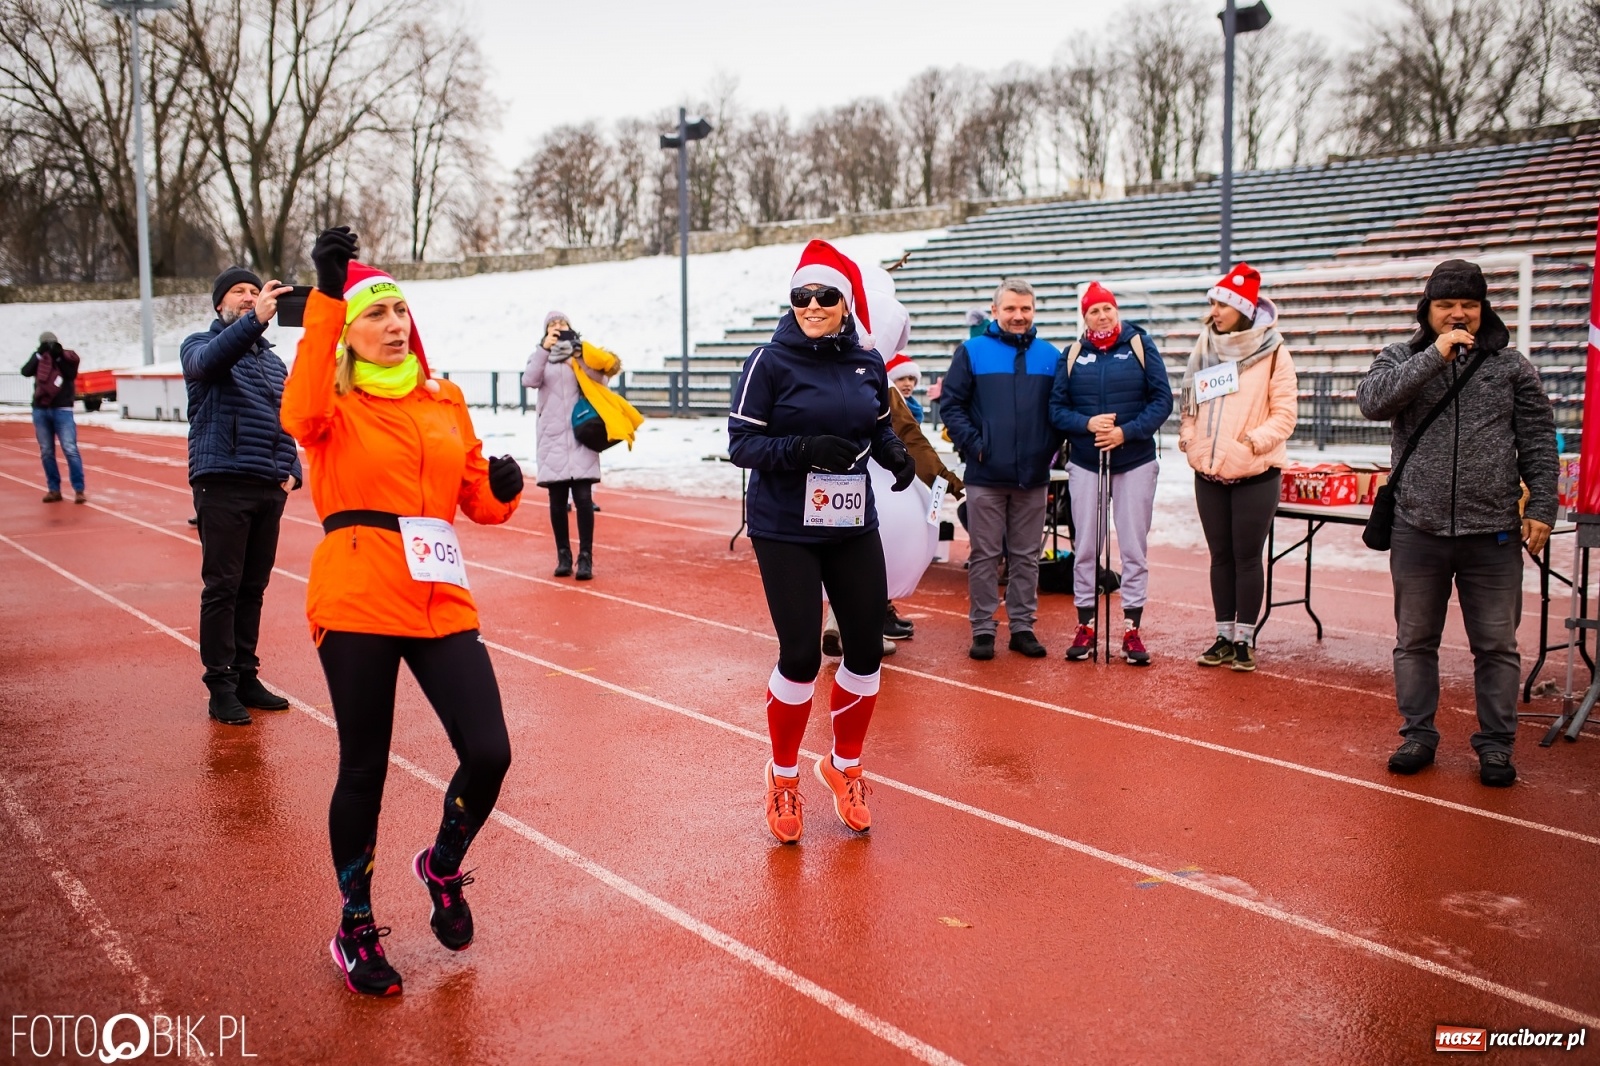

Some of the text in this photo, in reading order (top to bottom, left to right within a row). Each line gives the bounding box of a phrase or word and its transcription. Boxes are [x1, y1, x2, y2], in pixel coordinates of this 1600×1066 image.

[1210, 373, 1233, 388] 064
[832, 493, 861, 510] 050
[434, 541, 459, 567] 051
